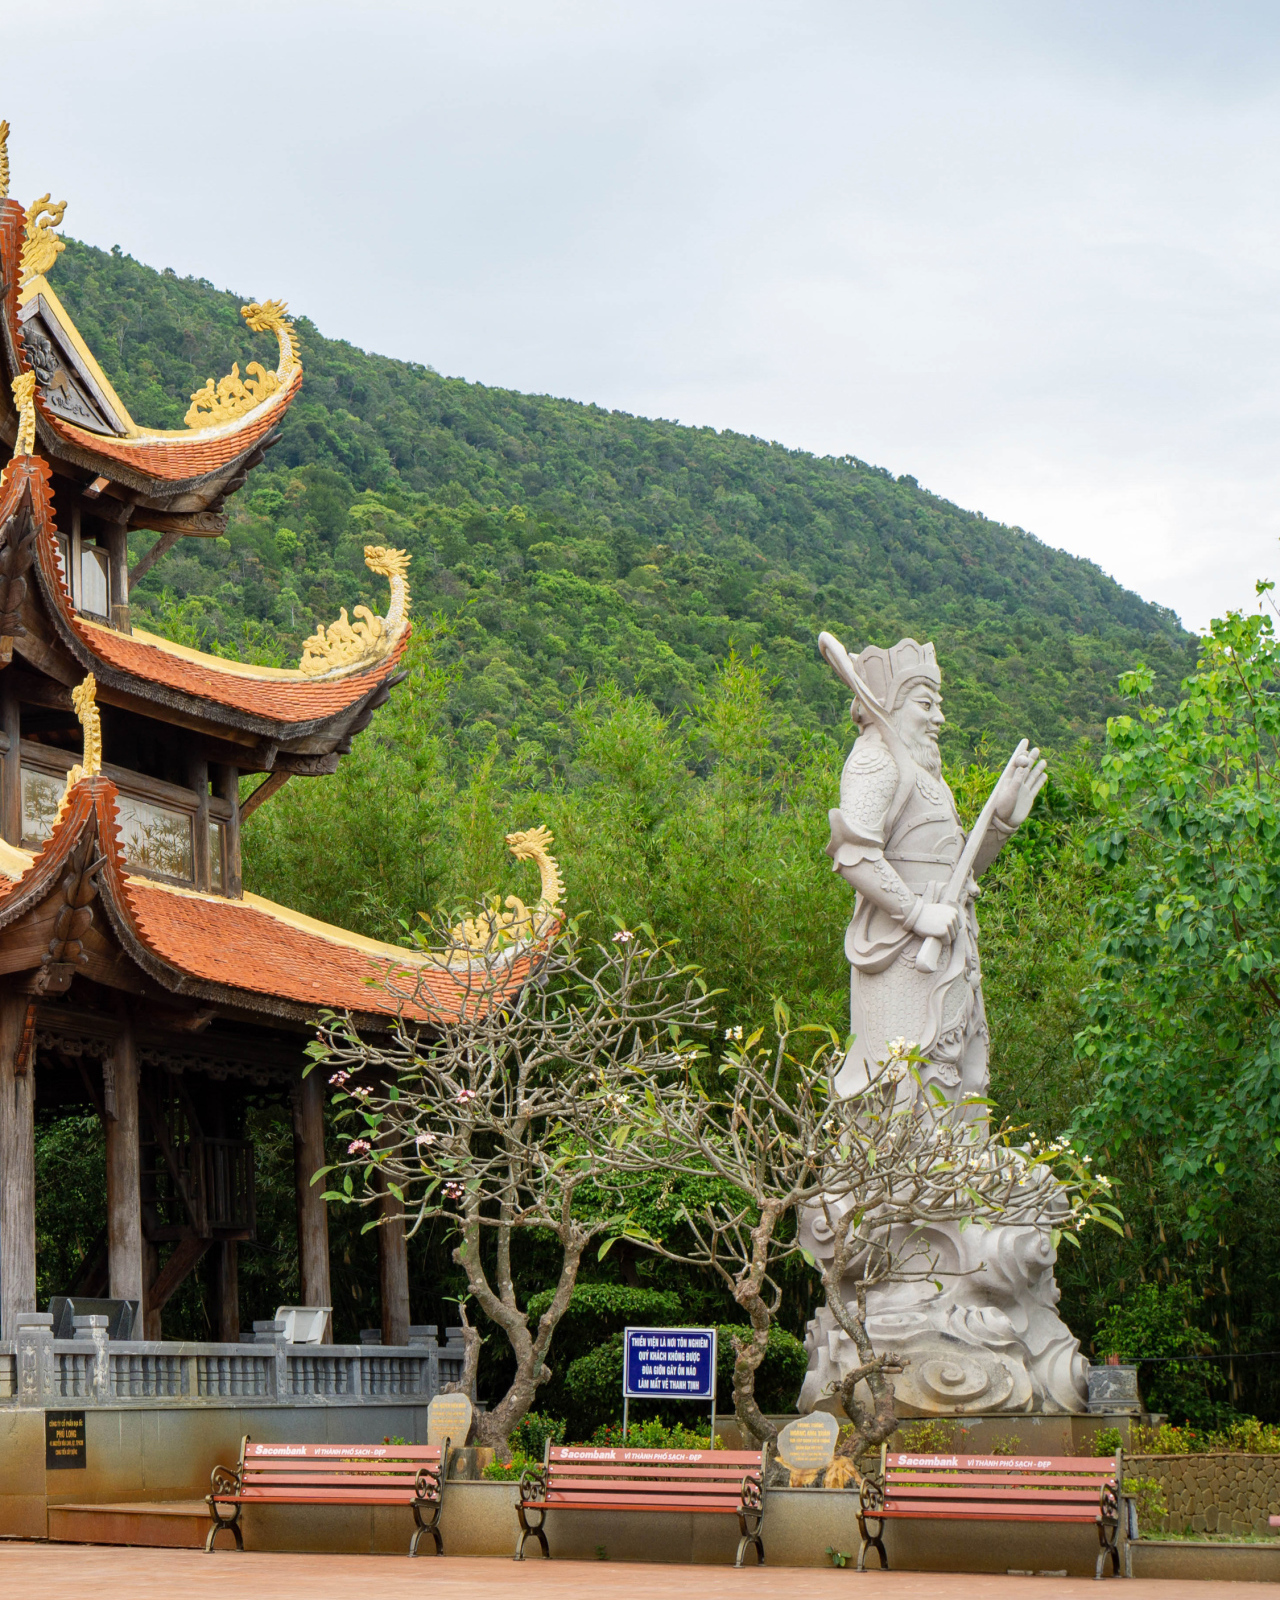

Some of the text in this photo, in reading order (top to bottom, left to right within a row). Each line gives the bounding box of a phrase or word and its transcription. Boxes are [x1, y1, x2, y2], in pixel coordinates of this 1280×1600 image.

[647, 1335, 659, 1349] VIỆN
[660, 1336, 667, 1347] LÀ
[677, 1336, 687, 1348] TÔN
[688, 1336, 709, 1348] NGHIÊM
[638, 1349, 700, 1363] QUÝ KHÁCH KHÔNG ĐƯỢC
[666, 1364, 677, 1375] GÂY
[638, 1377, 649, 1389] LÀM
[650, 1377, 661, 1389] MẤT
[669, 1380, 686, 1390] THANH
[687, 1380, 700, 1392] TỊNH
[65, 1429, 77, 1438] LONG
[255, 1444, 307, 1455] Sacombank
[314, 1447, 321, 1455] VÌ
[341, 1448, 355, 1456] PHỐ
[355, 1448, 370, 1457] SẠCH
[374, 1449, 387, 1457] ĐẸP
[560, 1448, 616, 1459] Sacombank
[631, 1452, 653, 1460] THÀNH
[653, 1452, 668, 1460] PHỐ
[668, 1453, 685, 1462] SẠCH
[689, 1454, 702, 1462] ĐẸP
[898, 1454, 958, 1466] Sacombank
[975, 1459, 999, 1467] THÀNH
[999, 1459, 1015, 1467] PHỐ
[1015, 1460, 1033, 1469] SẠCH
[1037, 1461, 1052, 1469] ĐẸP
